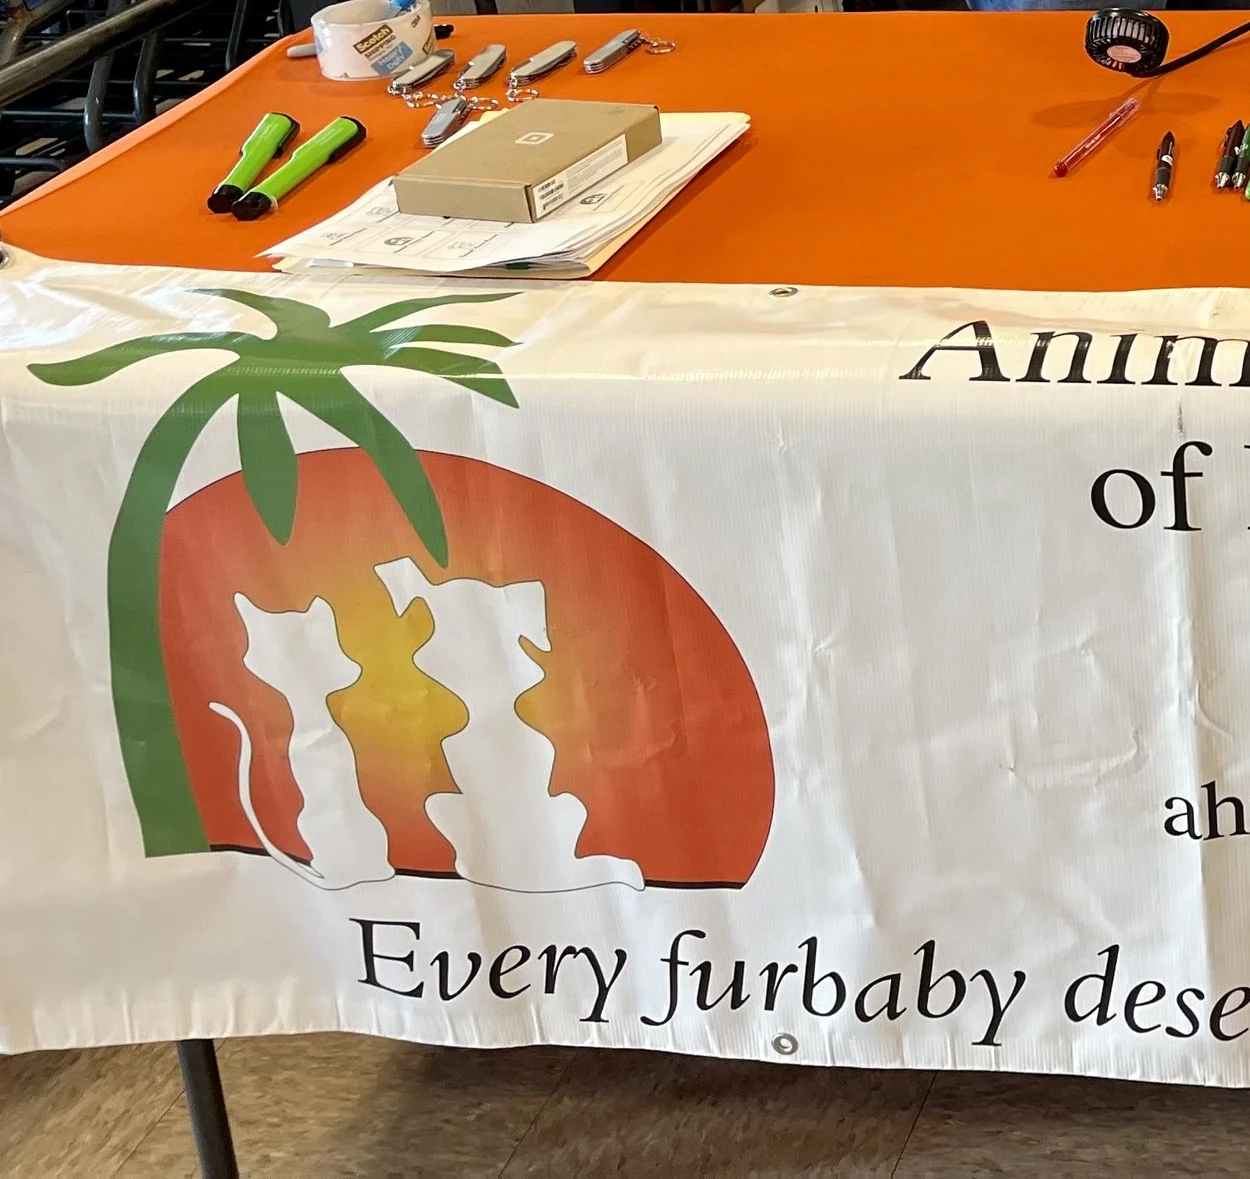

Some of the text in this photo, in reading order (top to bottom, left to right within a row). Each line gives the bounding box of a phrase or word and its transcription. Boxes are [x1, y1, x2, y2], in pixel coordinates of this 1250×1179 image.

[356, 26, 391, 51] Scotch
[363, 34, 397, 58] SHIPPING
[1091, 441, 1212, 531] of
[349, 918, 627, 1023] Every
[640, 929, 1026, 1046] furbaby
